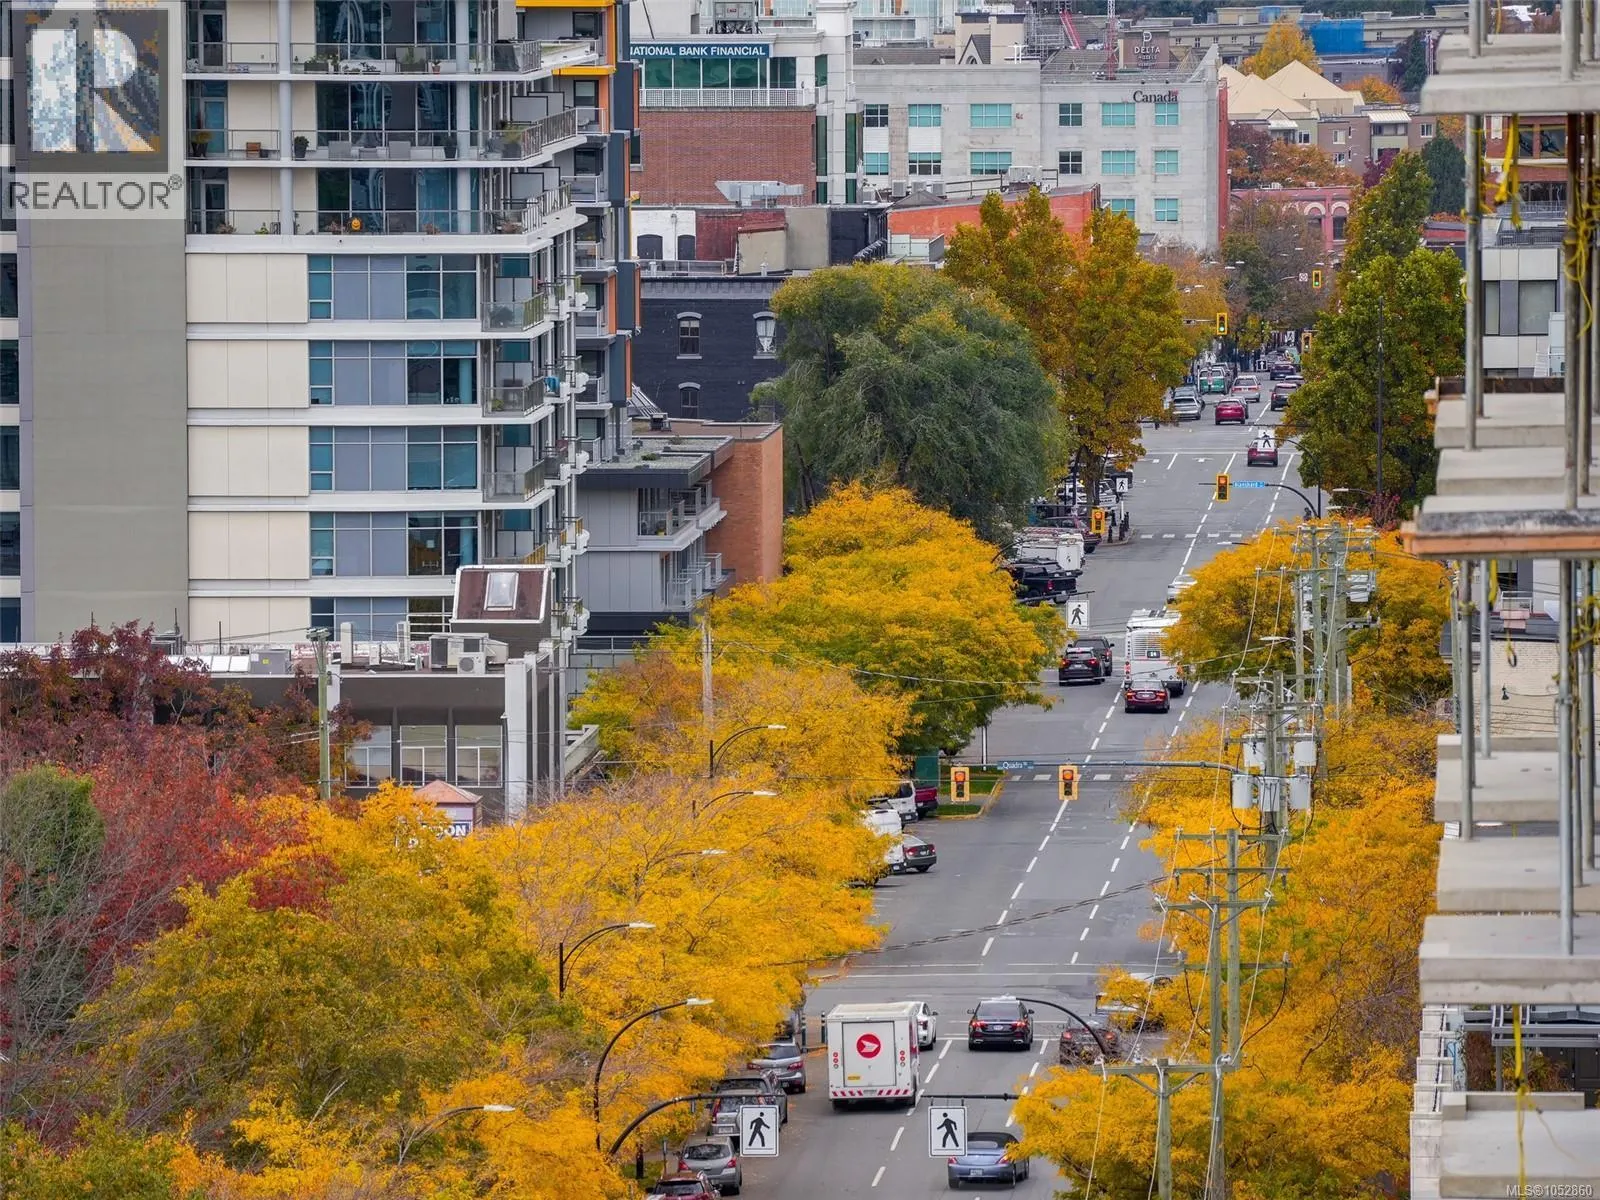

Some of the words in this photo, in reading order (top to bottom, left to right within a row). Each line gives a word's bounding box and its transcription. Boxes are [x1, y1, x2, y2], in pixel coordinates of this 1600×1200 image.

[679, 46, 707, 56] BANK
[710, 46, 765, 56] FINANCIAL
[1134, 46, 1160, 54] DELTA
[1133, 90, 1178, 103] Canada
